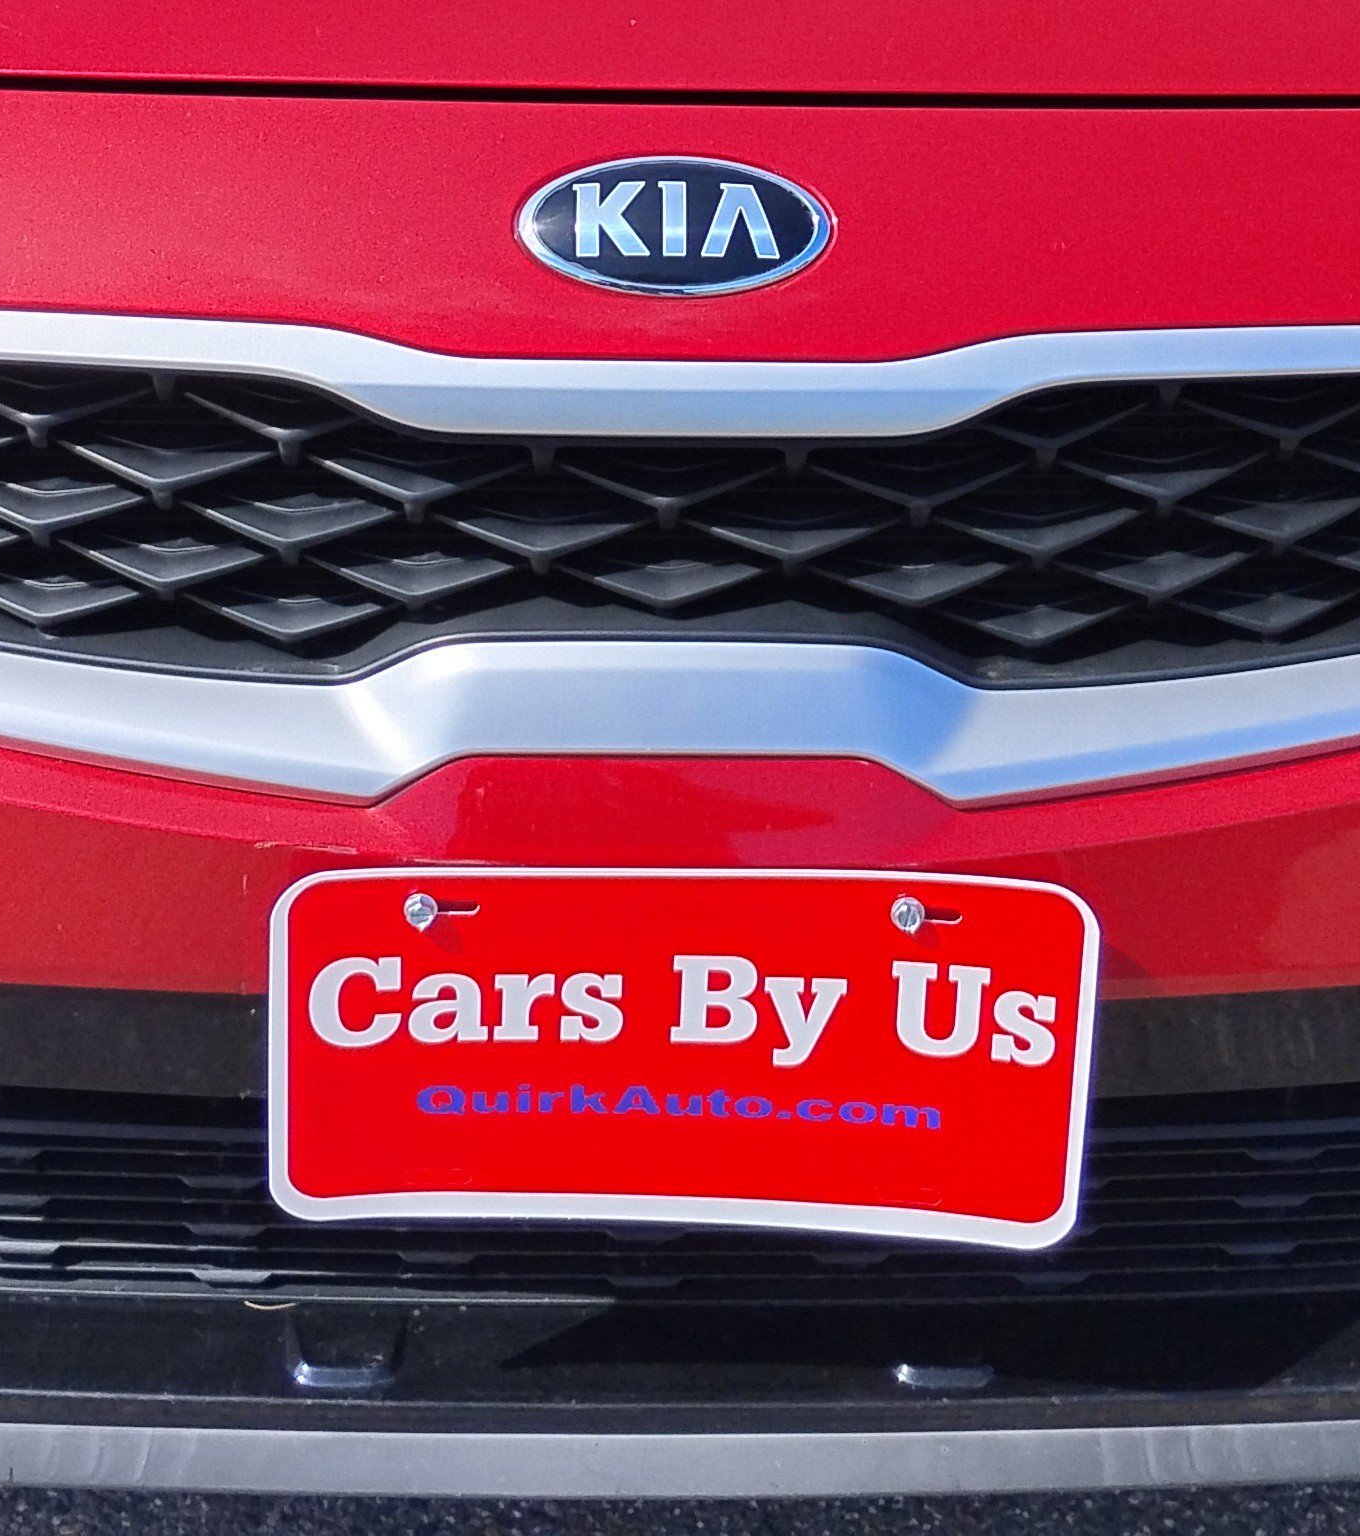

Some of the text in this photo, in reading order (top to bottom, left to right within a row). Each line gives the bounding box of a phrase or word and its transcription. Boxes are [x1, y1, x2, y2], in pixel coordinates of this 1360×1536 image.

[572, 180, 780, 259] KIA
[307, 955, 1059, 1068] Cars By Us
[416, 1083, 942, 1131] QuirkAuto.com
